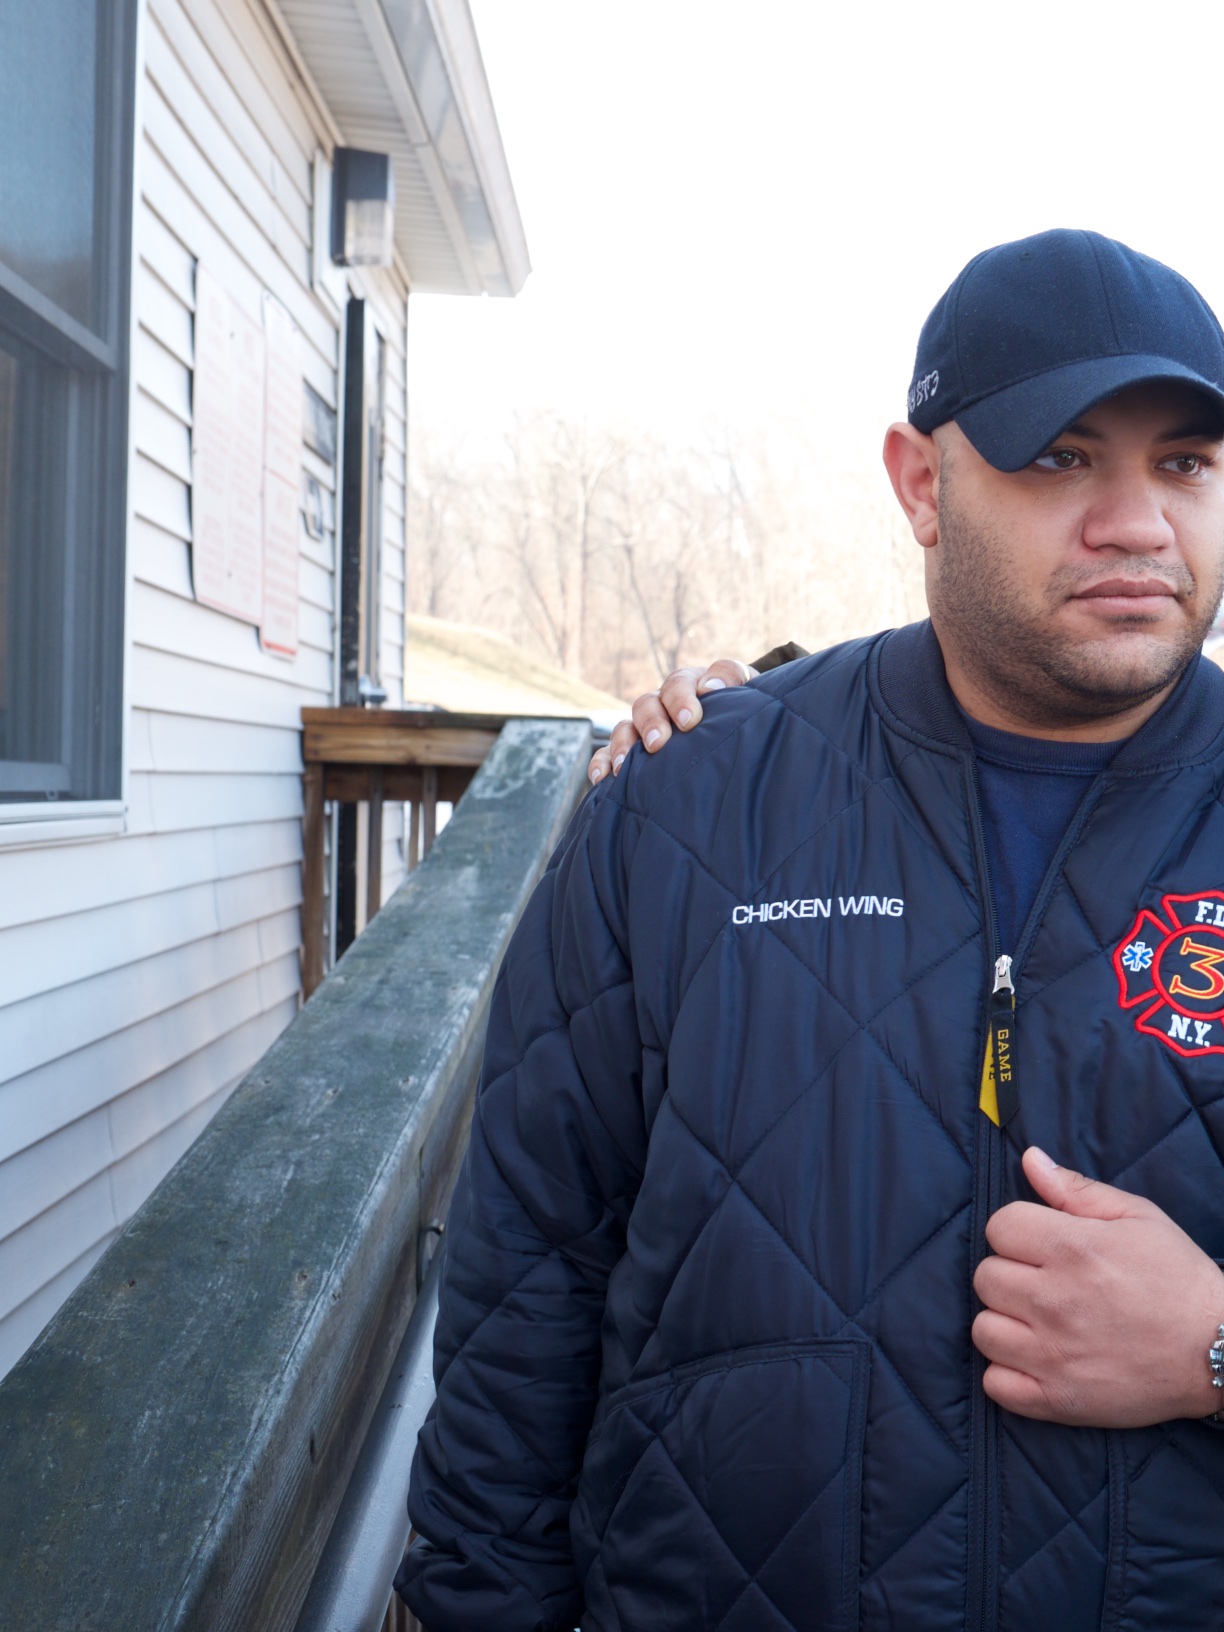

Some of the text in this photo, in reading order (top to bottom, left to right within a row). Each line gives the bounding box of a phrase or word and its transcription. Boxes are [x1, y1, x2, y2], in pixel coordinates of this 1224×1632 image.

[732, 896, 904, 924] CHICKEN WING
[1167, 1014, 1212, 1047] N.Y.
[997, 1029, 1011, 1082] GAME
